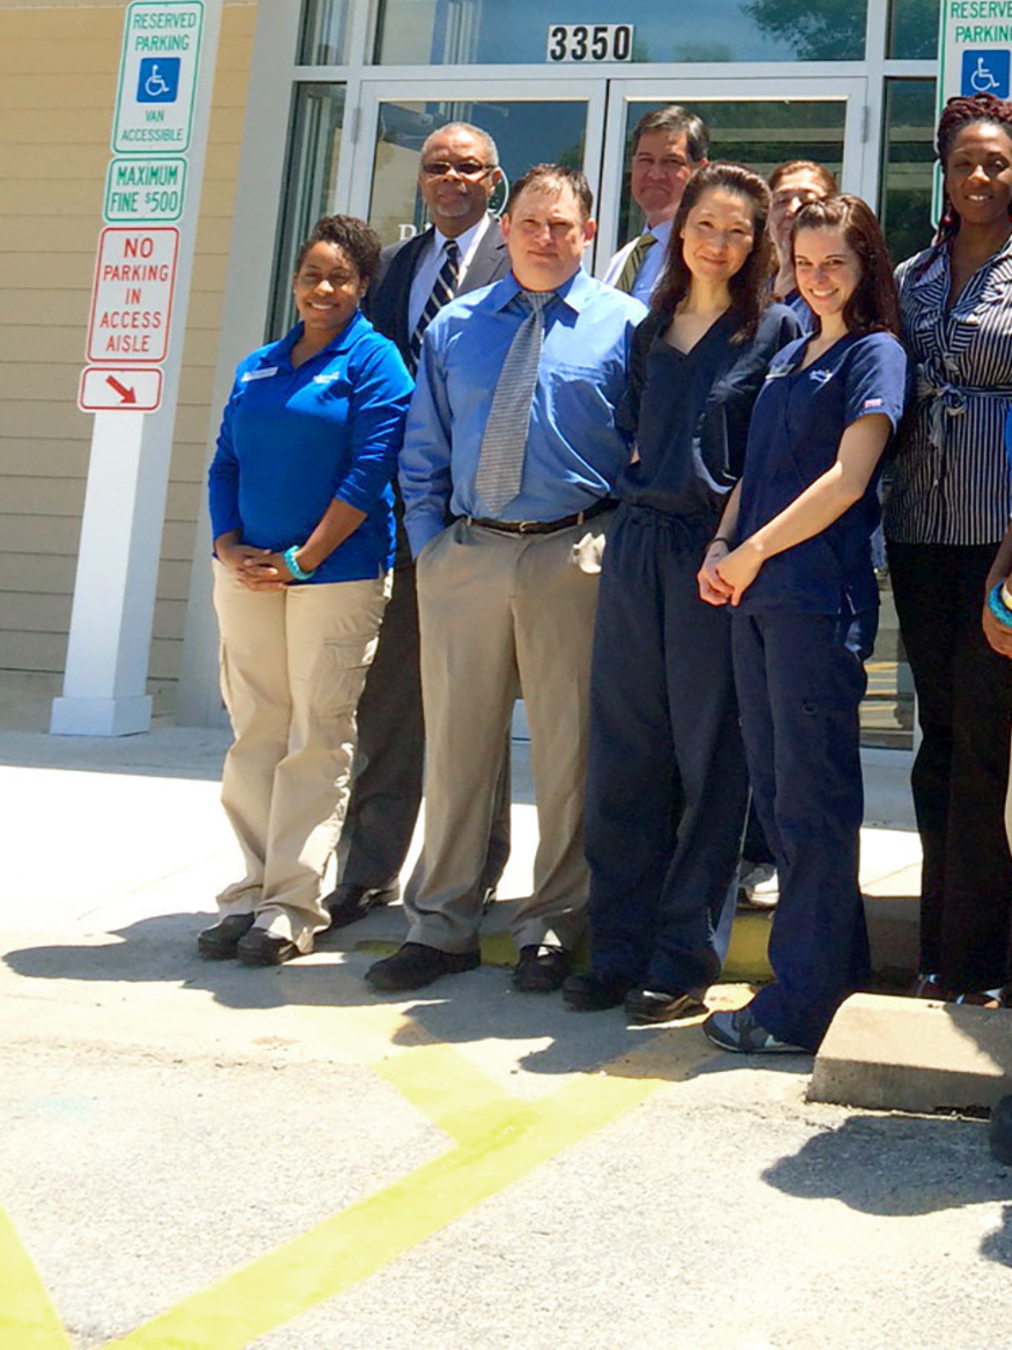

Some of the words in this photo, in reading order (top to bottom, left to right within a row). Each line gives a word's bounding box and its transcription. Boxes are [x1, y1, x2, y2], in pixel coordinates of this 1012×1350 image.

[133, 12, 197, 29] RESERVED
[135, 35, 190, 51] PARKING
[550, 25, 631, 61] 3350
[145, 110, 164, 123] VAN
[121, 128, 184, 142] ACCESSIBLE
[116, 166, 178, 186] MAXIMUM
[110, 191, 139, 212] FINE
[144, 191, 178, 212] $500
[123, 237, 154, 259] NO
[103, 264, 169, 281] PARKING
[125, 288, 141, 305] IN
[100, 311, 162, 328] ACCESS
[105, 335, 151, 352] AISLE
